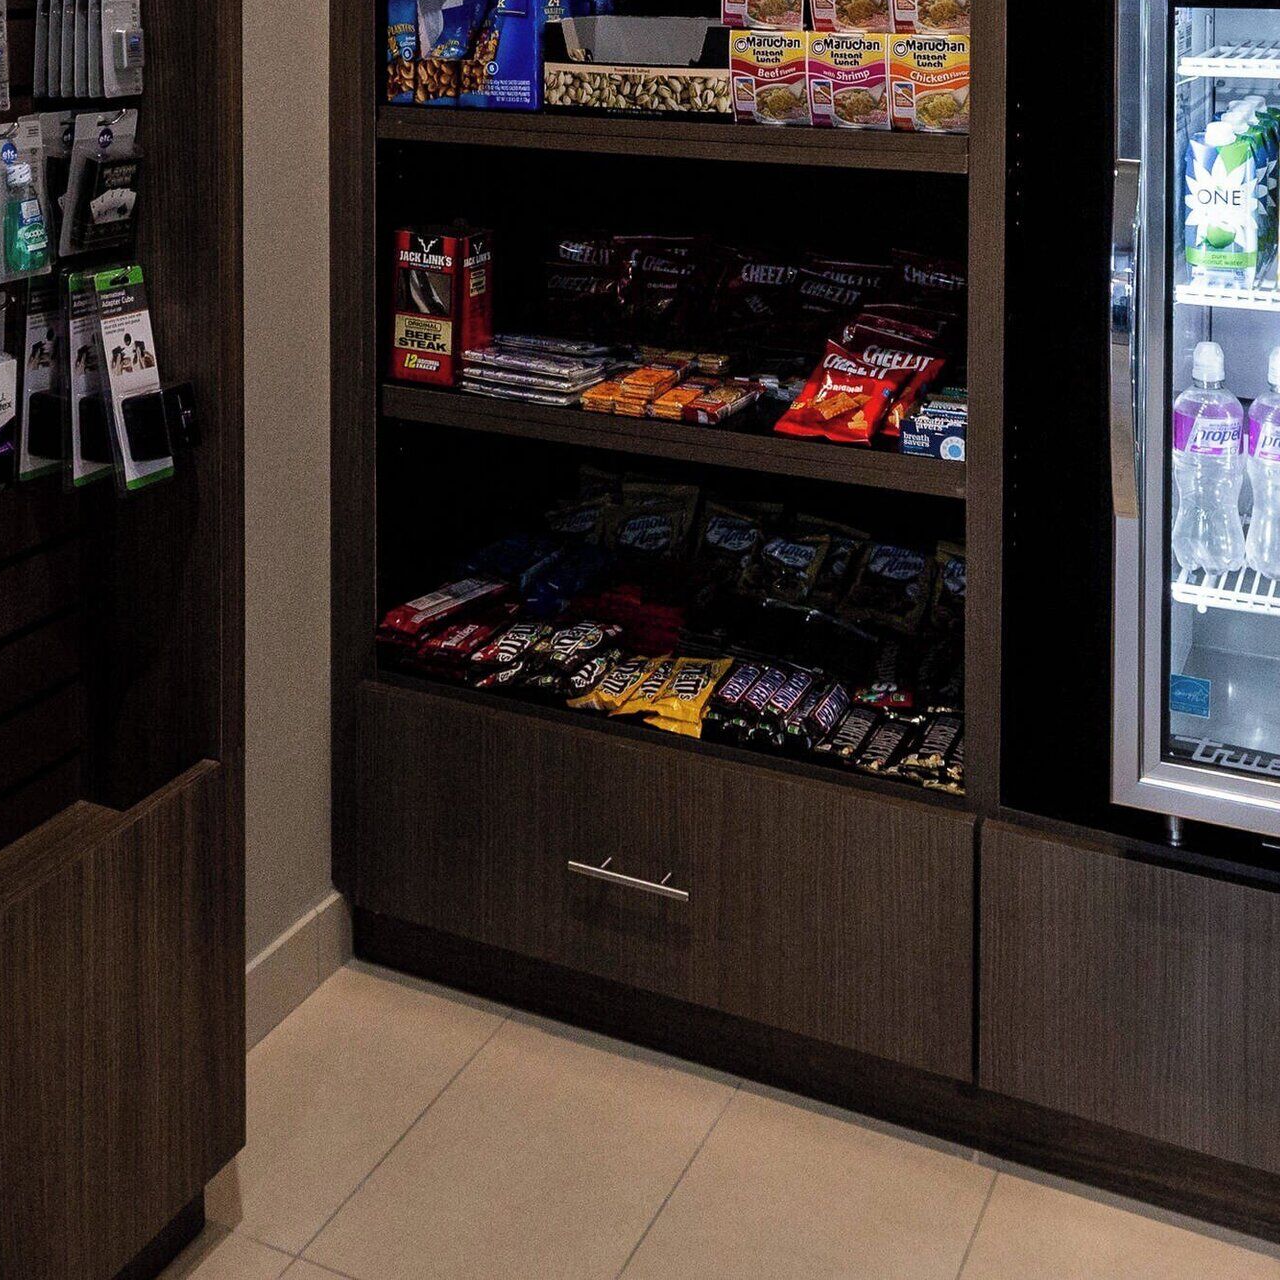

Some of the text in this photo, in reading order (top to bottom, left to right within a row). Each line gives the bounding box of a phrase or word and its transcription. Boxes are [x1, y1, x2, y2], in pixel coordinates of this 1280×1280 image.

[746, 36, 800, 48] Maruchan
[823, 38, 880, 51] Maruchan
[906, 39, 965, 52] Maruchan
[753, 48, 784, 57] Instant
[831, 52, 863, 60] Instant
[913, 53, 947, 62] Instant
[756, 55, 781, 63] Lunch
[834, 58, 860, 67] Lunch
[916, 60, 944, 68] Lunch
[757, 67, 779, 78] Beef
[836, 69, 870, 81] Shrimp
[909, 70, 949, 83] Chicken
[1196, 188, 1243, 206] ONE
[400, 250, 453, 267] JACK LINK'S
[121, 295, 135, 304] Cube
[405, 329, 442, 342] BEEF
[398, 337, 448, 353] STEAK
[404, 353, 417, 369] 12
[904, 431, 930, 442] breath
[1194, 425, 1241, 445] propel
[904, 439, 930, 449] savers
[749, 670, 785, 707] SNICKERS
[773, 673, 811, 709] SNICKERS
